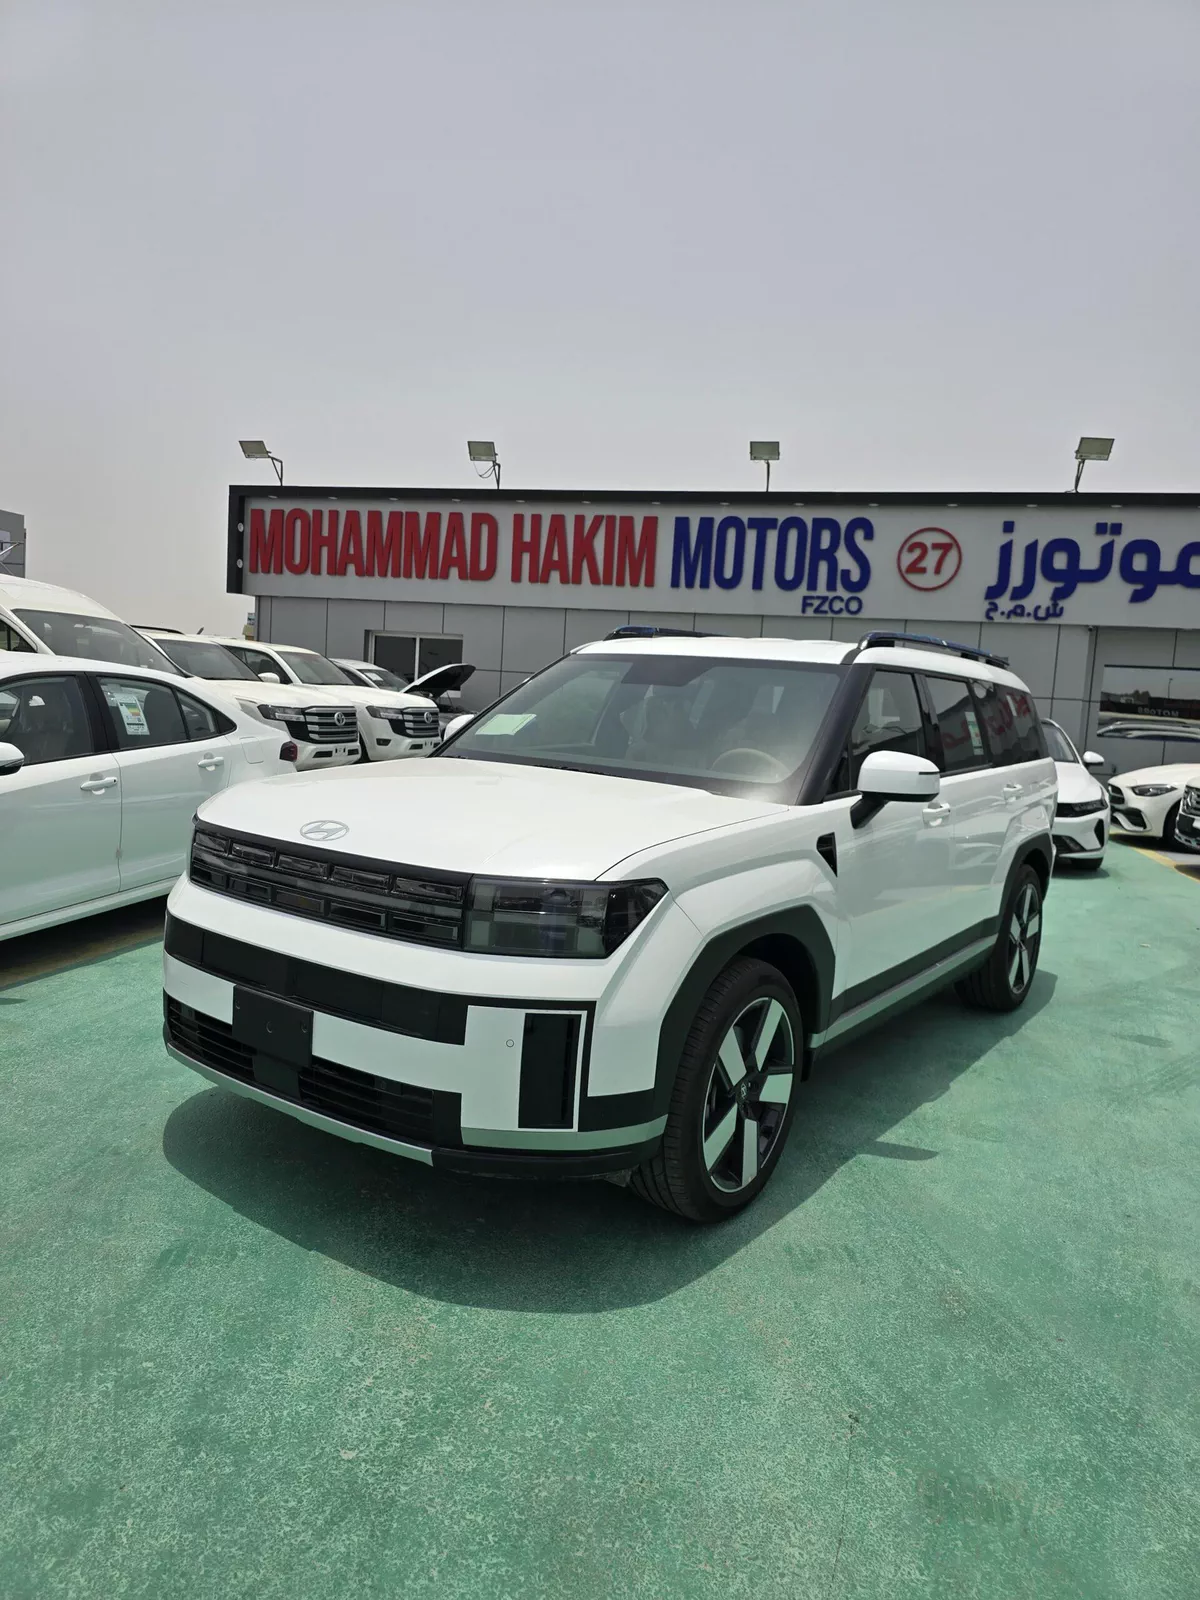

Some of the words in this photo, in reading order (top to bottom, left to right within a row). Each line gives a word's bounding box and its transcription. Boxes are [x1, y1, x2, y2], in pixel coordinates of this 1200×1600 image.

[249, 508, 499, 581] MOHAMMAD
[510, 513, 659, 588] HAKIM
[670, 515, 874, 594] MOTORS
[904, 541, 955, 577] 27
[801, 595, 863, 616] FZCO
